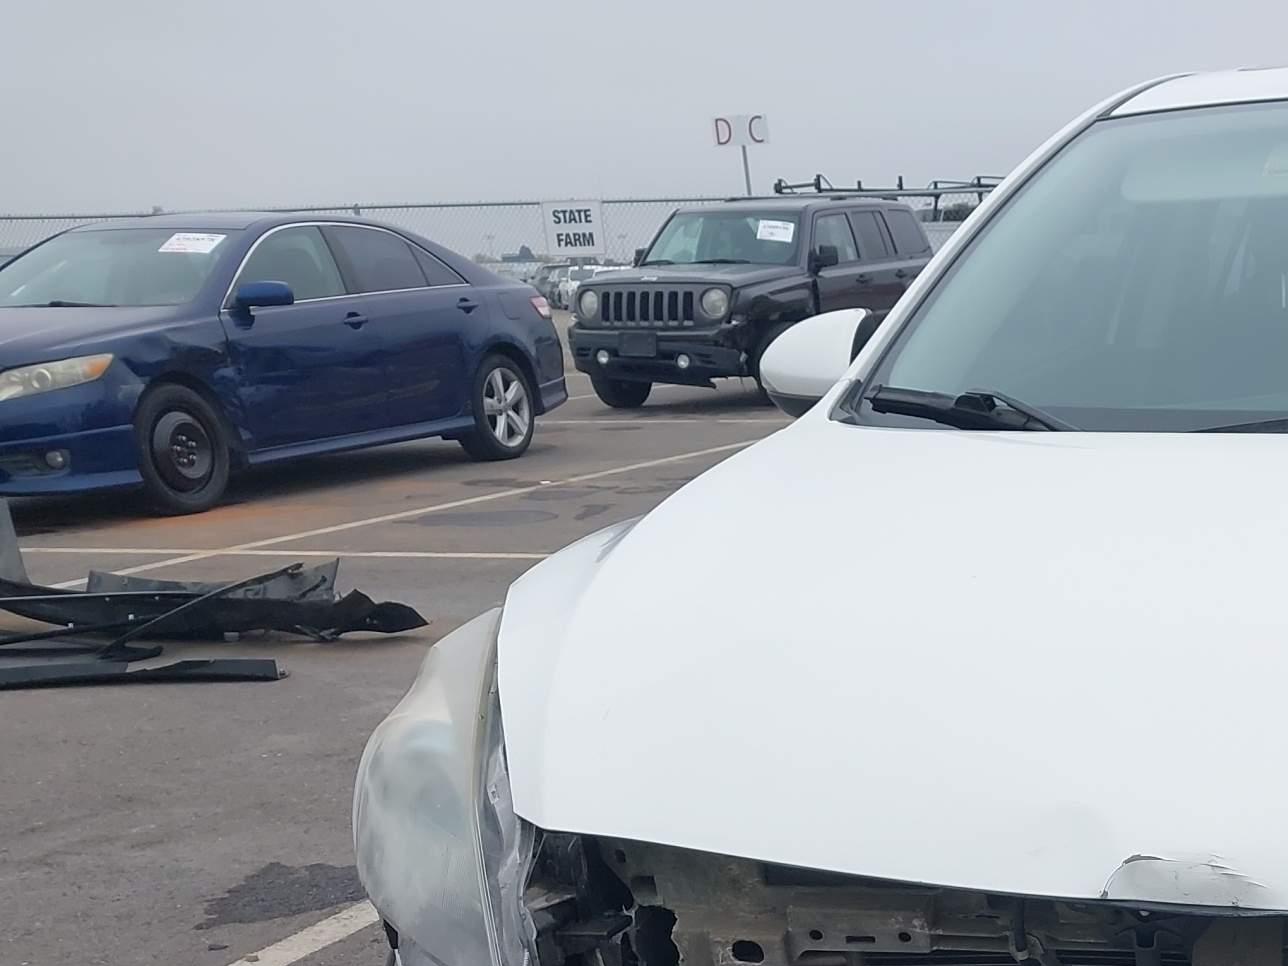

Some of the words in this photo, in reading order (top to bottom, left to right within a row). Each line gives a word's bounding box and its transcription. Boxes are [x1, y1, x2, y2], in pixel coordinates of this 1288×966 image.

[715, 118, 731, 145] D
[749, 115, 764, 143] C
[552, 208, 592, 224] STATE
[556, 231, 595, 248] FARM
